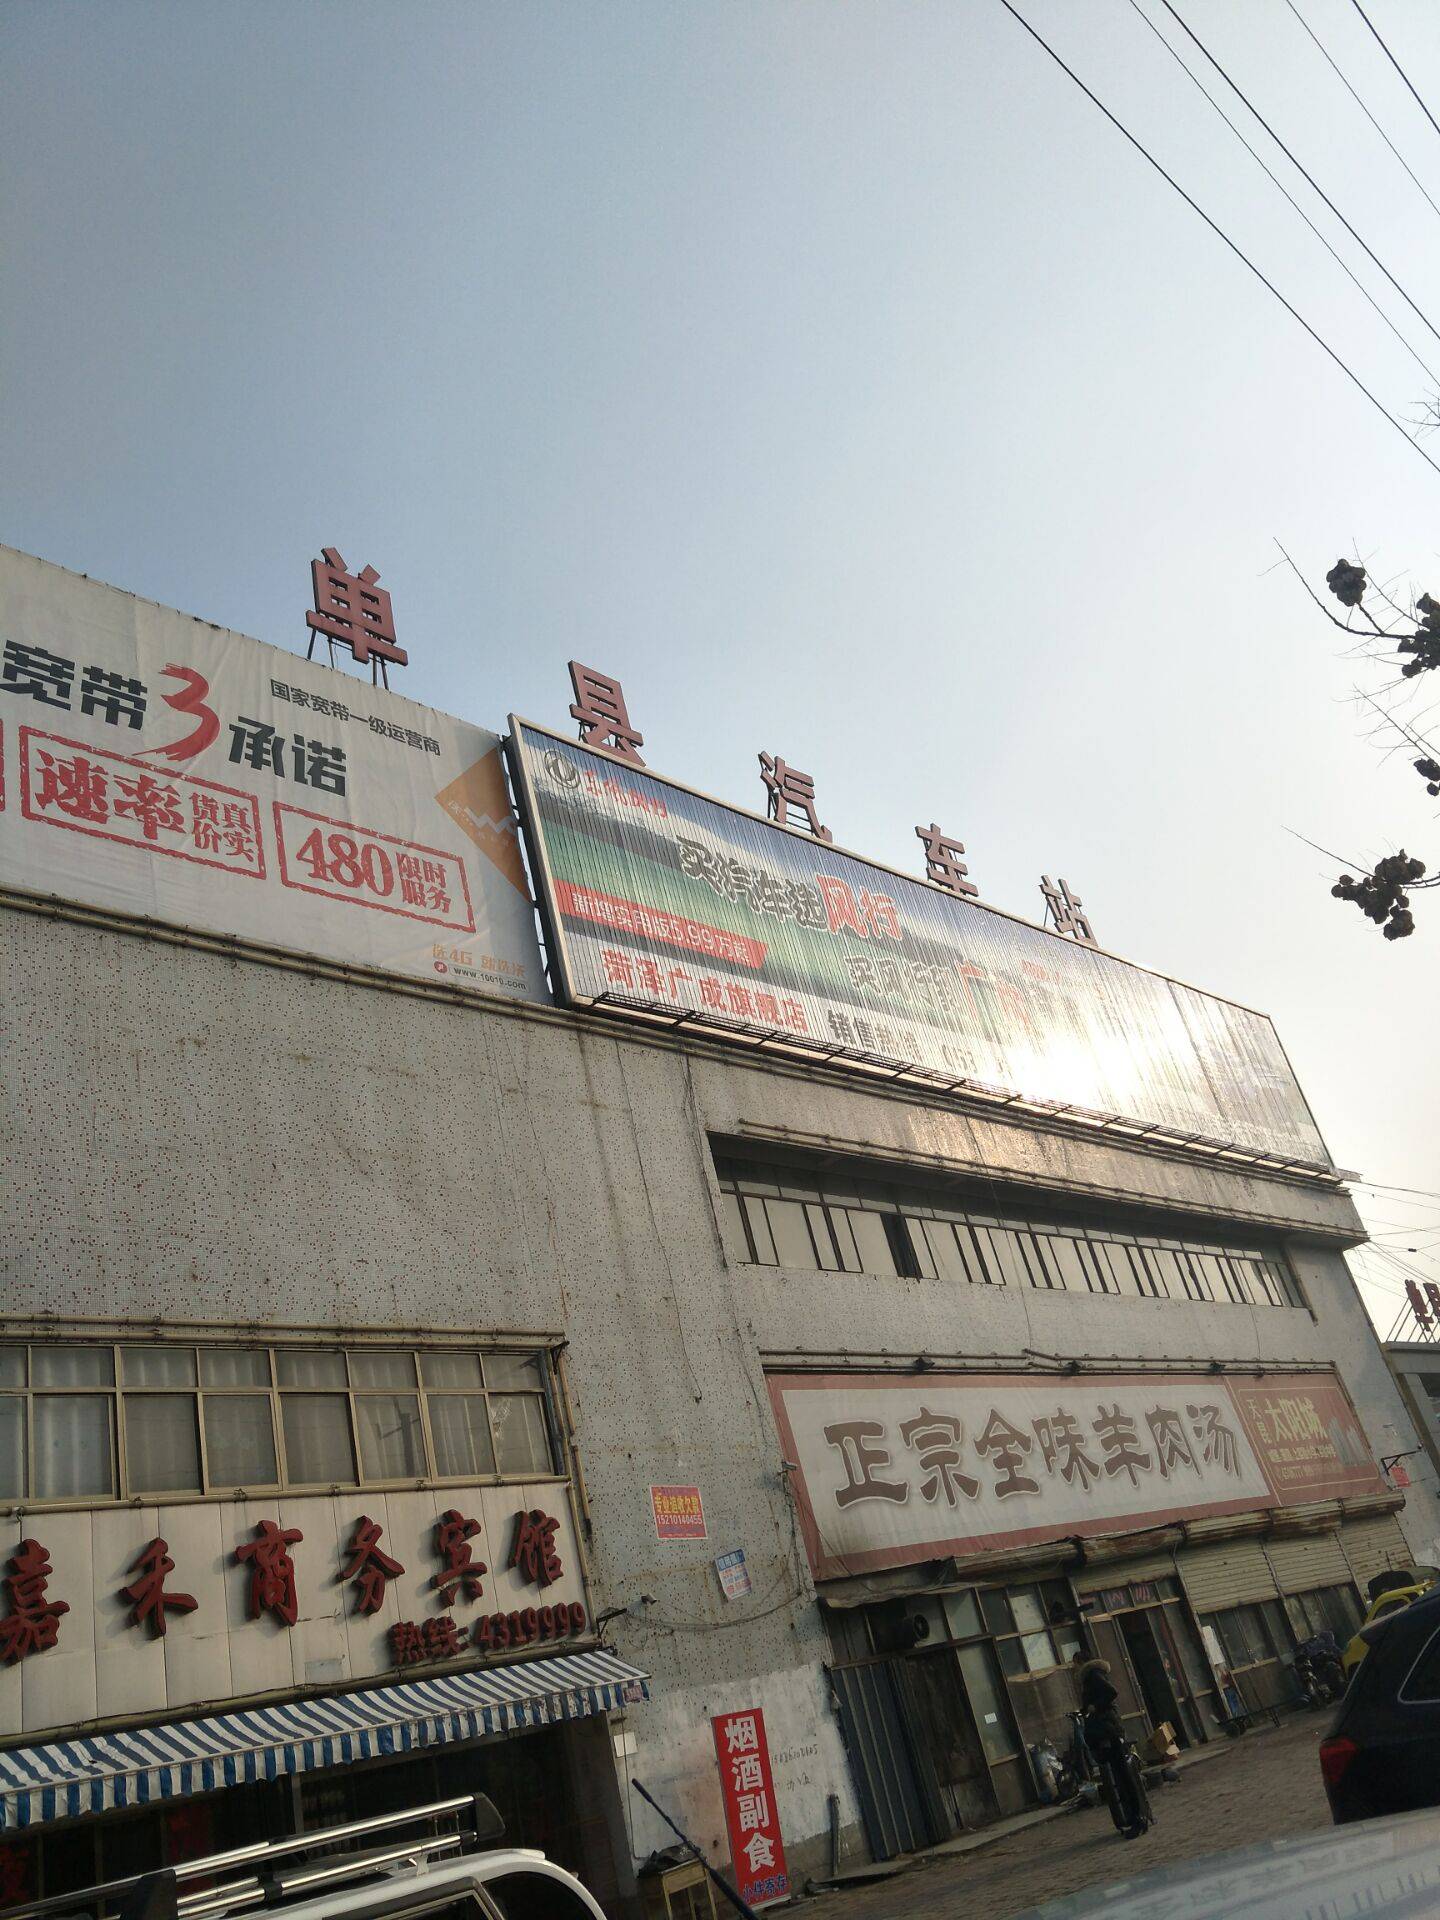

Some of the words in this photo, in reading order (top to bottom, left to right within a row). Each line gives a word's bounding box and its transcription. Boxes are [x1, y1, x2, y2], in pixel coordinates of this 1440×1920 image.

[1, 639, 347, 797] 宽带3承诺
[270, 679, 441, 756] 国家宽带一级运营商
[35, 750, 187, 840] 速率
[295, 827, 396, 899] 480
[396, 852, 447, 889] 限时
[400, 877, 452, 914] 服务
[453, 966, 528, 989] www.10010.com
[601, 950, 809, 1033] 菏泽广成旗舰店
[824, 1403, 1242, 1510] 正宗全味羊肉汤
[0, 1508, 565, 1667] 嘉禾商务宾馆
[724, 1714, 777, 1873] 烟酒副食
